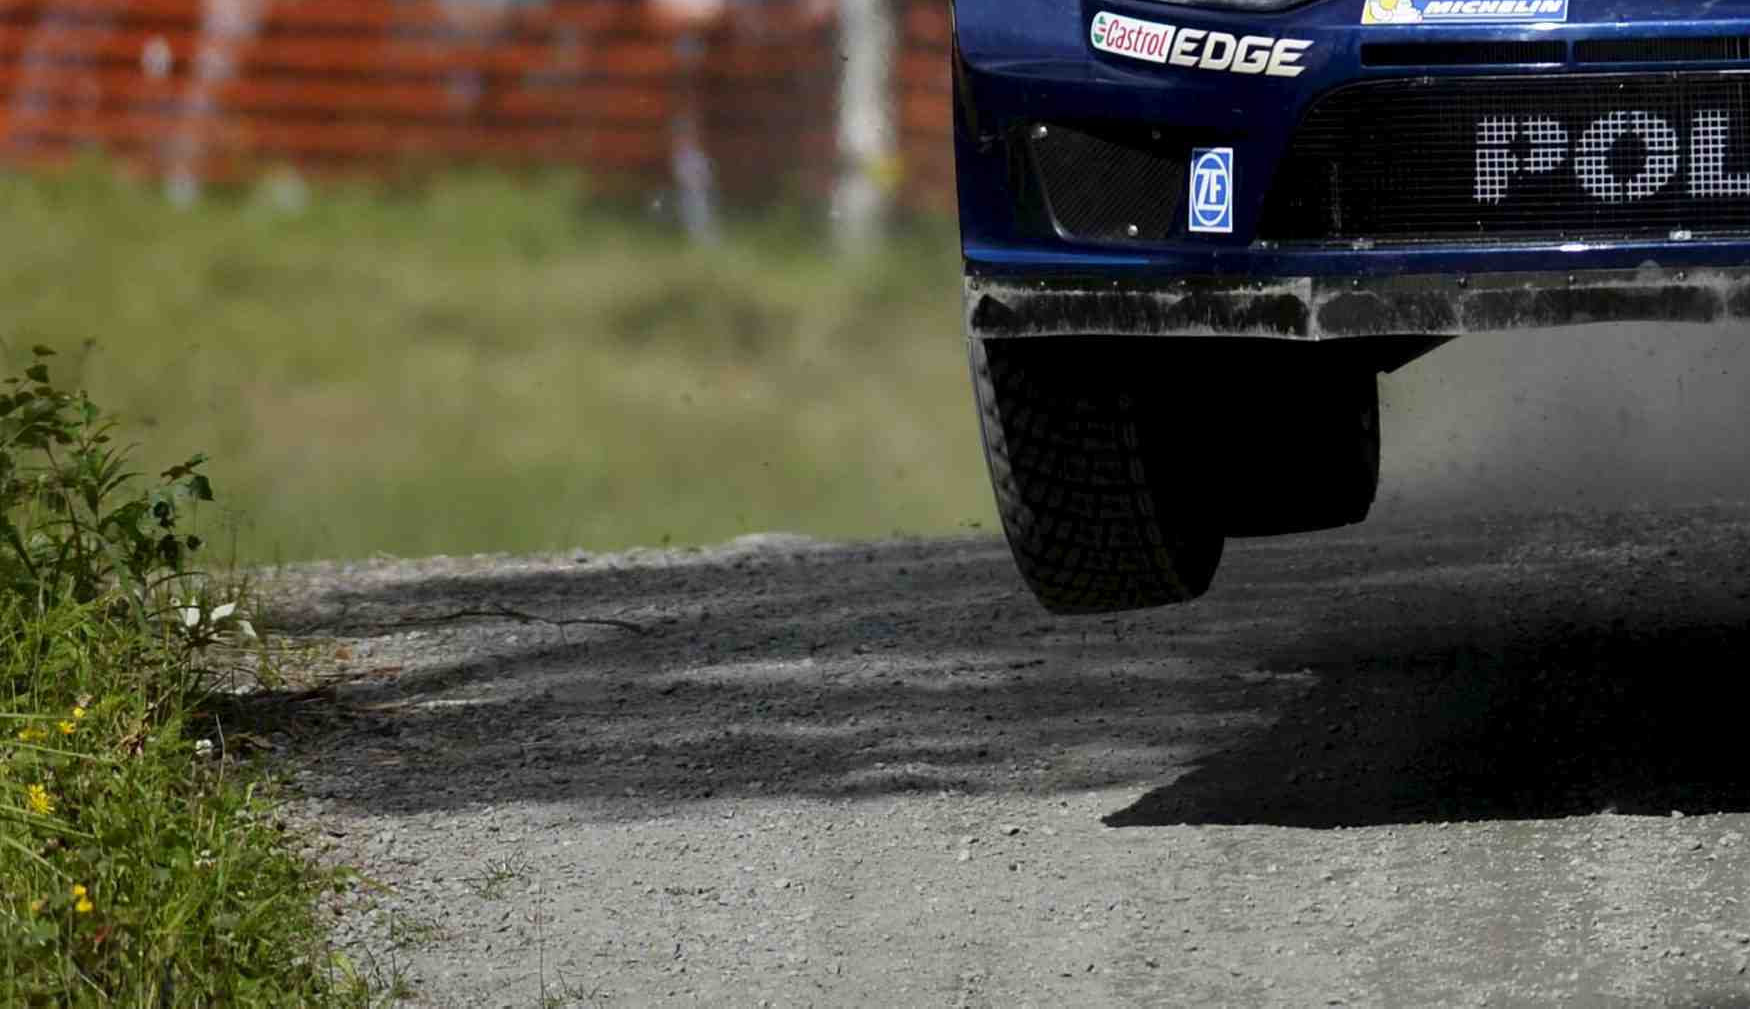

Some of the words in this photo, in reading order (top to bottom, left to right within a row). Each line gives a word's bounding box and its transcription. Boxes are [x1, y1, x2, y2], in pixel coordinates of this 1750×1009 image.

[1106, 18, 1169, 58] Castrol
[1168, 27, 1315, 78] EDGE
[1196, 167, 1227, 212] ZF
